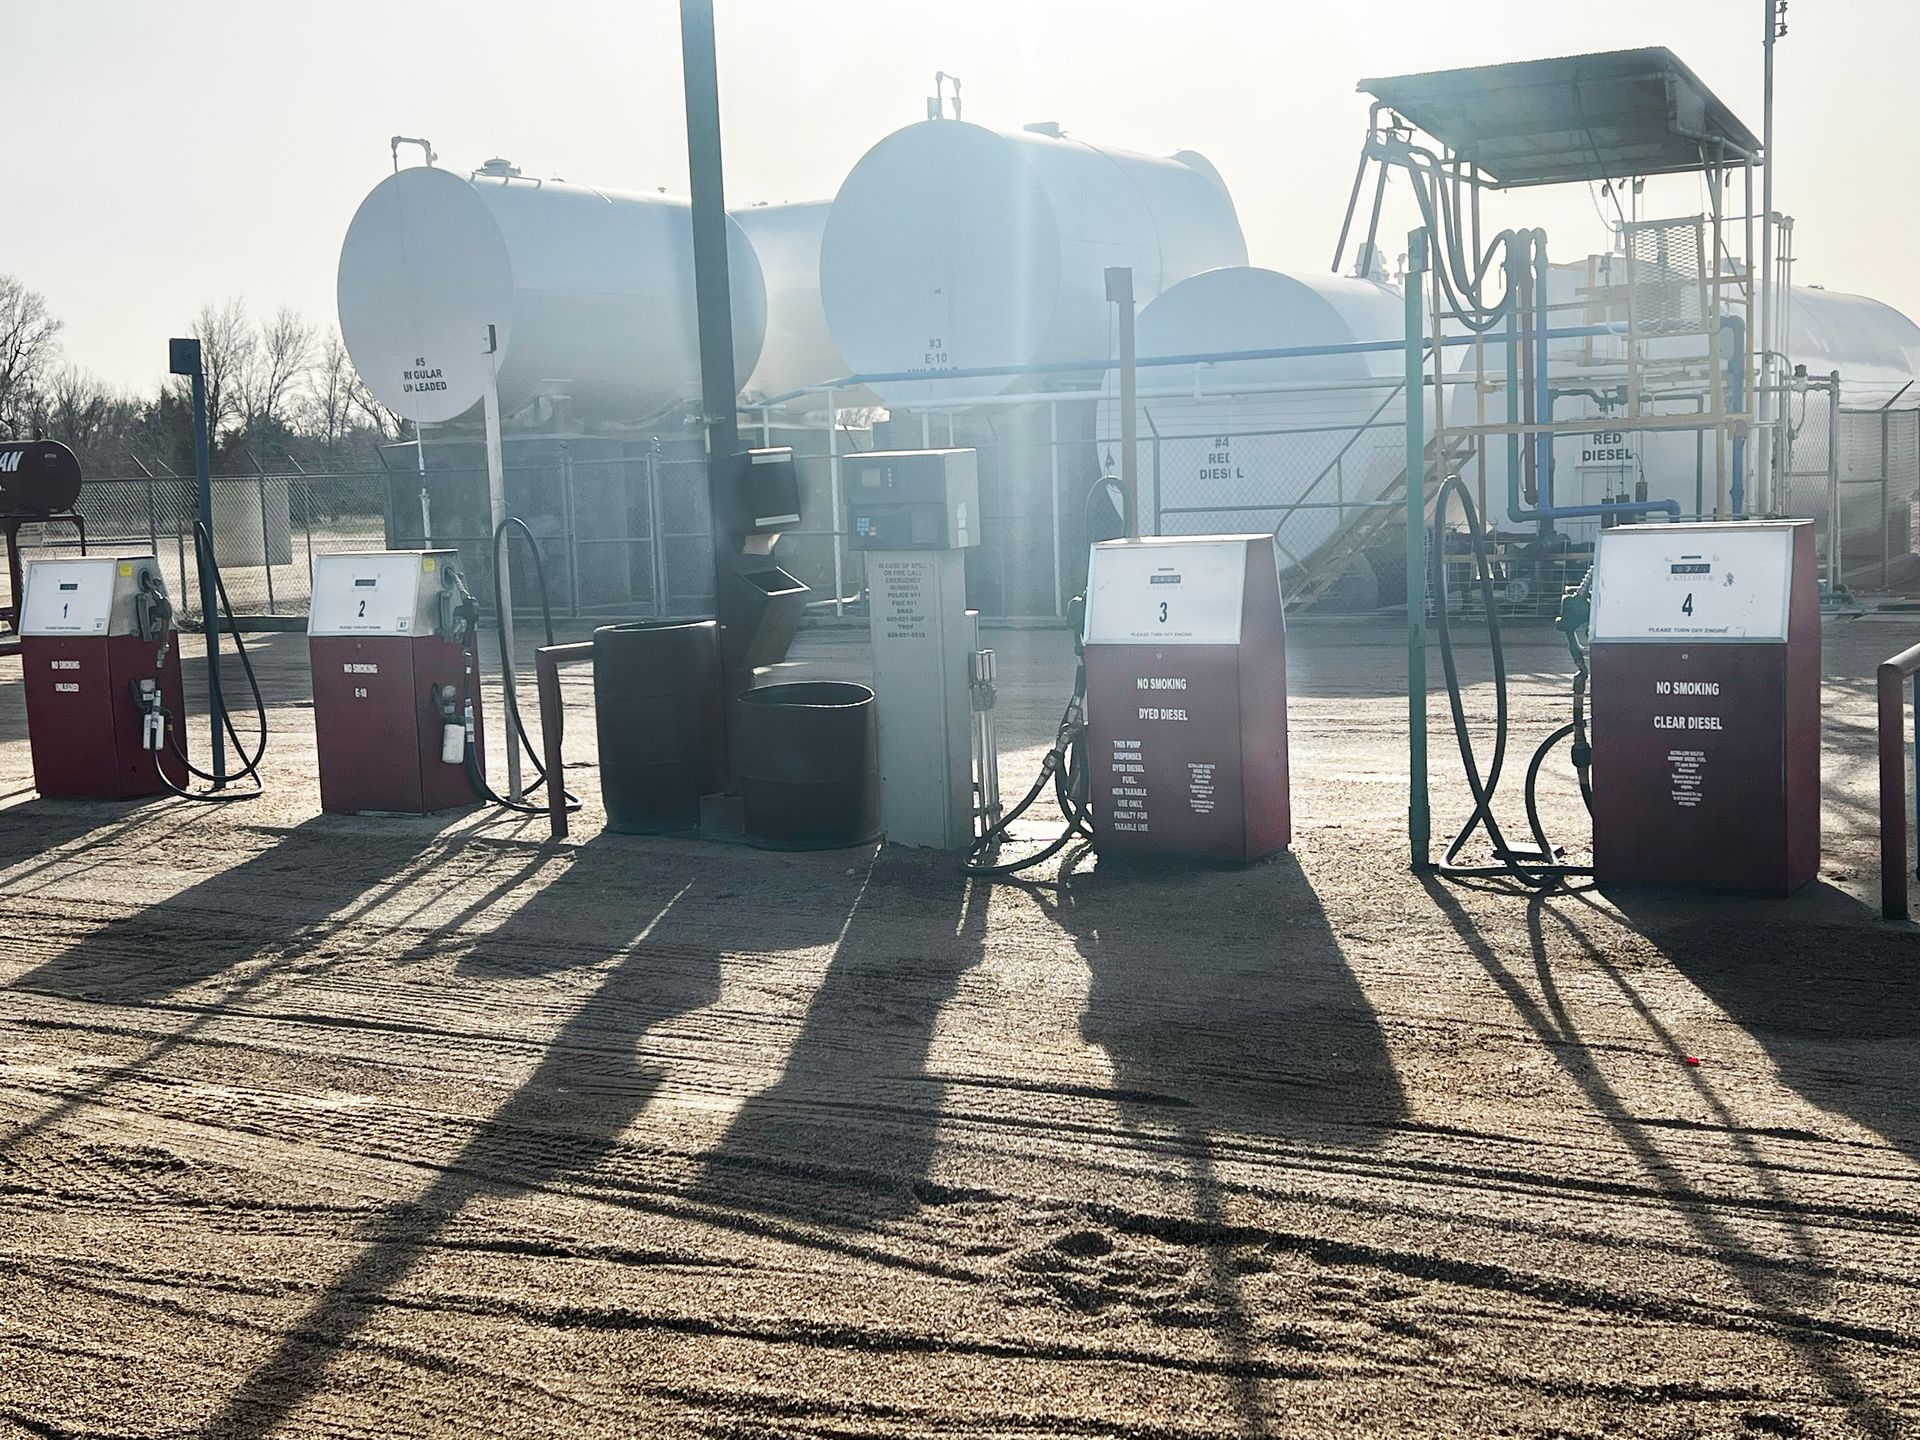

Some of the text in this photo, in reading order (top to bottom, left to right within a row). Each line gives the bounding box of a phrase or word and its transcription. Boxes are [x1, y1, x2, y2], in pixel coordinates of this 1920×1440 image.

[930, 338, 942, 349] #3
[415, 357, 426, 367] #5
[925, 352, 947, 364] E-10
[1215, 436, 1230, 449] #4
[1593, 433, 1622, 445] RED
[1582, 448, 1633, 462] DIESEL
[1200, 467, 1244, 480] DIESL
[63, 603, 68, 619] 1
[358, 600, 366, 618] 2
[1682, 593, 1693, 617] 4
[1159, 602, 1167, 623] 3
[343, 663, 378, 674] NO SMOKING
[1137, 678, 1187, 690] NO SMOKING
[1656, 681, 1720, 696] NO SMOKING
[1138, 707, 1188, 721] DYED DIESEL
[1654, 715, 1723, 730] CLEAR DIESEL
[1113, 740, 1142, 749] THIS PUMP
[1114, 752, 1142, 761] DISPENSES
[1112, 764, 1145, 773] DYED DIESEL
[1112, 788, 1148, 797] NON TAXABLE
[1117, 800, 1129, 808] USE
[1113, 811, 1148, 820] PENALTY FOR
[1114, 823, 1149, 832] TAXABLE USE
